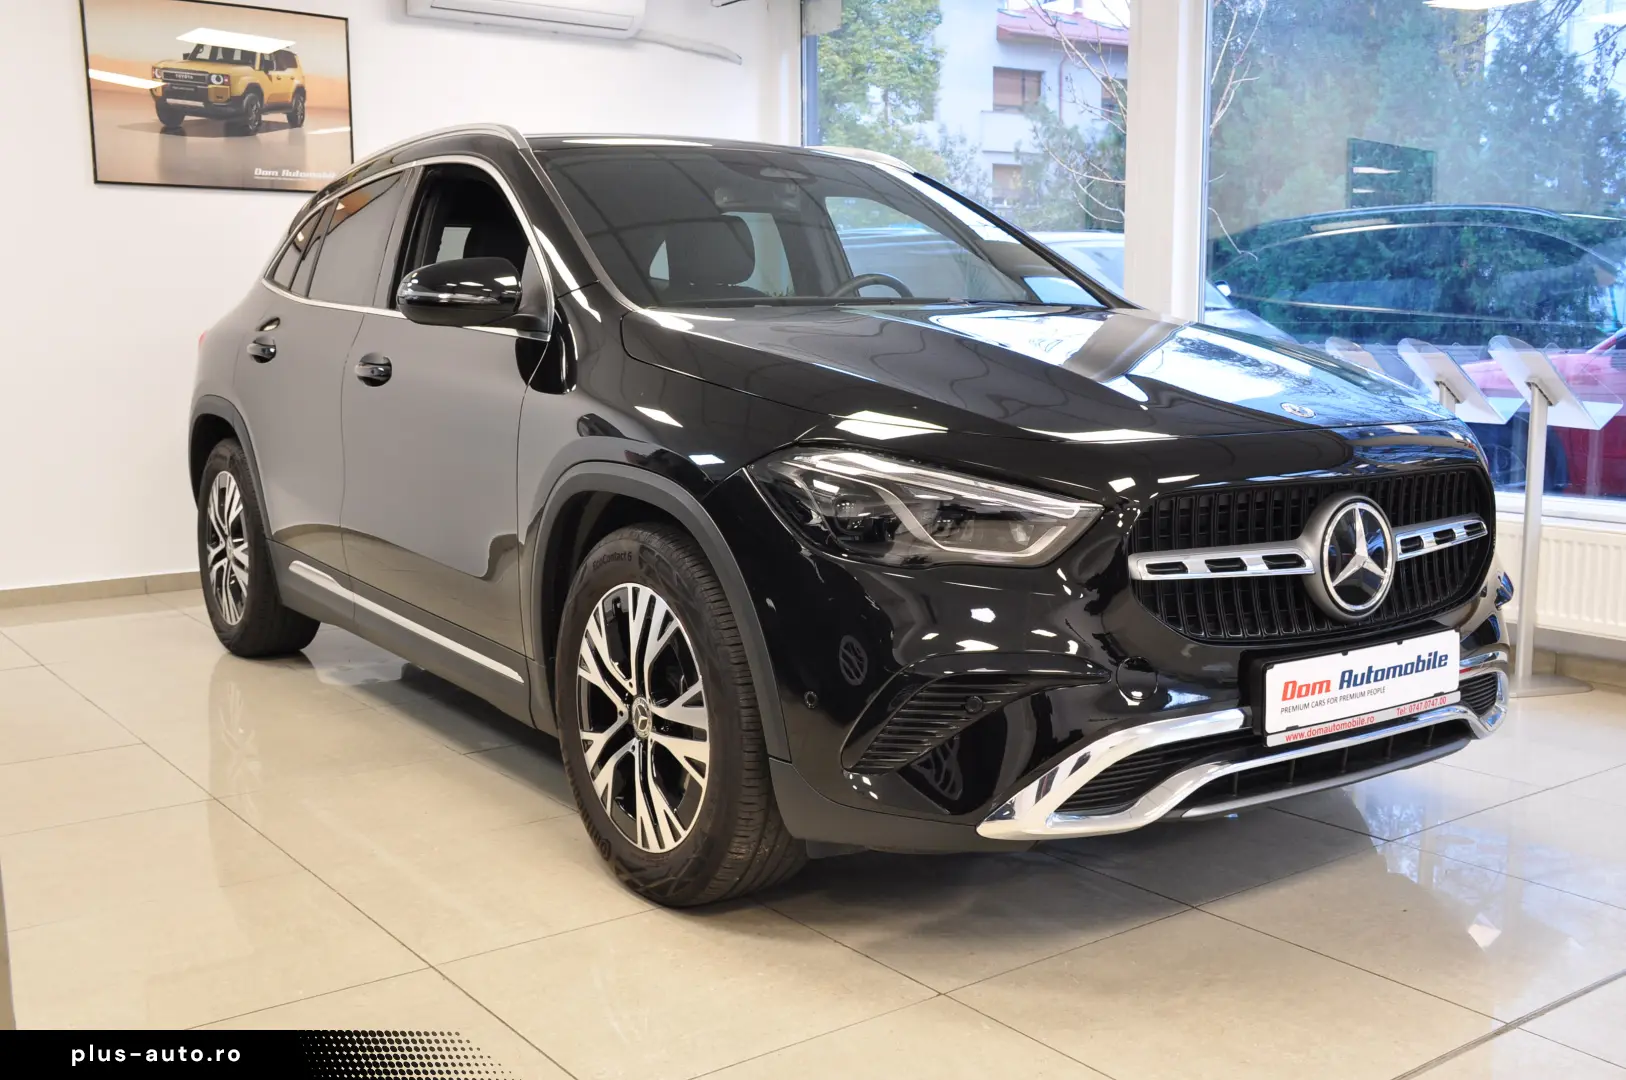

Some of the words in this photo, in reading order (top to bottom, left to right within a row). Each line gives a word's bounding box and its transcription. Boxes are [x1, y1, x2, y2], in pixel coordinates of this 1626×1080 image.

[254, 168, 278, 177] Dom
[627, 551, 632, 562] 6
[1281, 680, 1331, 702] Dom
[1338, 650, 1449, 691] Automobile
[1280, 703, 1310, 714] PREMIUM
[1310, 698, 1326, 709] CARS
[1327, 696, 1338, 705] FOR
[1339, 690, 1366, 702] PREMIUM
[1366, 686, 1386, 696] PEOPLE
[1285, 715, 1375, 742] www.domautomobile.ro
[1396, 705, 1406, 716] Tel:
[1408, 696, 1447, 713] 0747.0747.00
